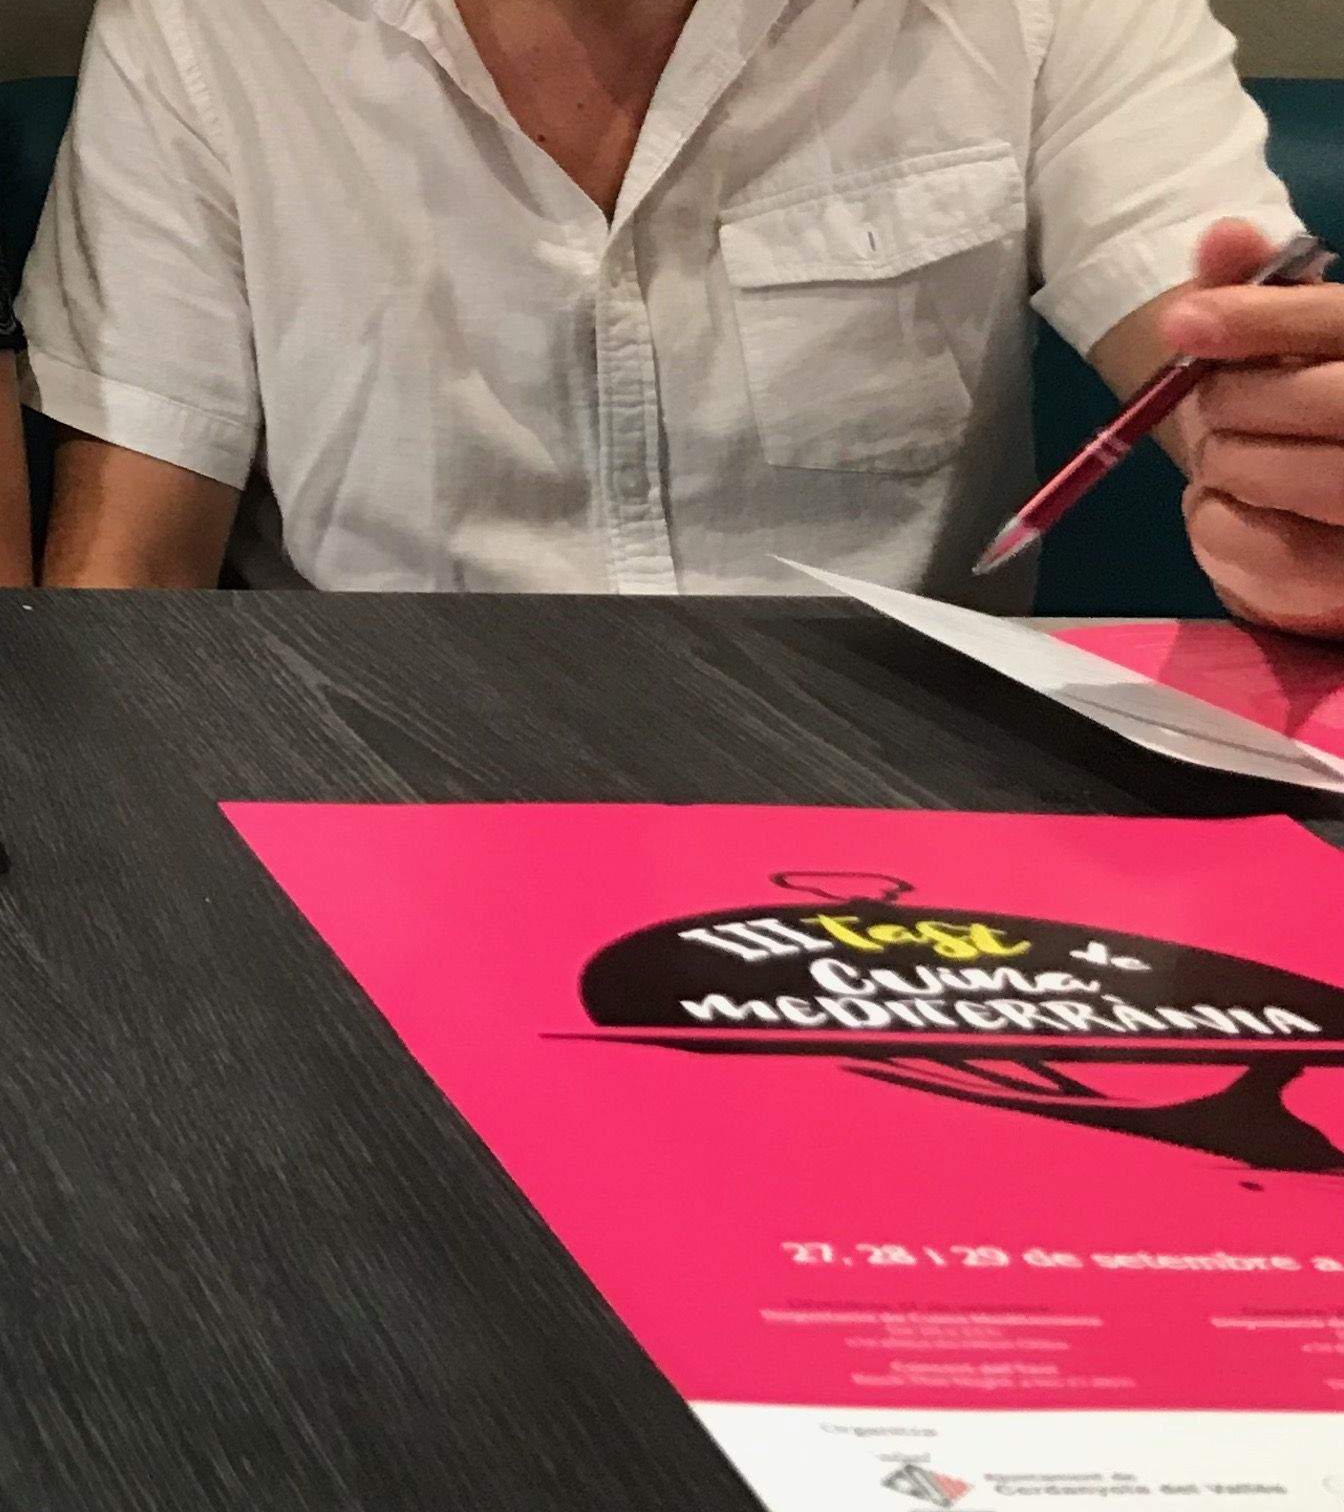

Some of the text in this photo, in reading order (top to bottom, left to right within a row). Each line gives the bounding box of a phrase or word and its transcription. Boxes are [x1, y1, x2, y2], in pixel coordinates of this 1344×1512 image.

[677, 917, 835, 963] III
[809, 956, 1102, 996] Cuina
[1022, 1248, 1084, 1269] de
[1089, 1251, 1303, 1272] setembre
